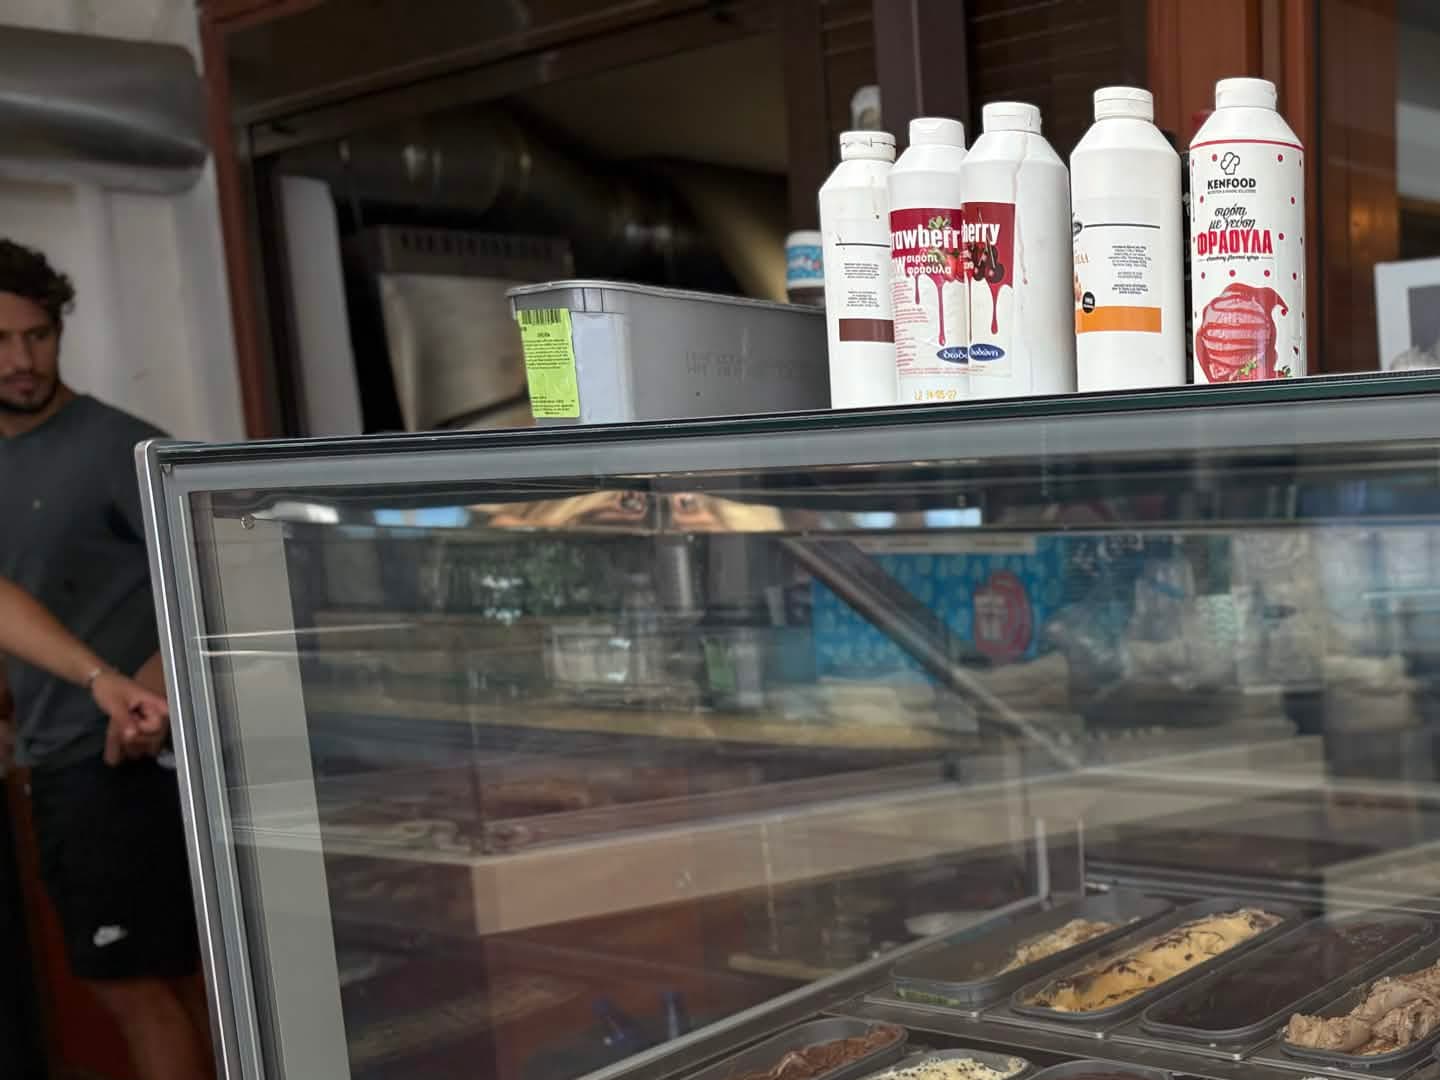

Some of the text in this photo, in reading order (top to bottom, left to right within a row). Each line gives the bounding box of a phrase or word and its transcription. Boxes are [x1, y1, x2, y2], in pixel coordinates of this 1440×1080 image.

[1207, 178, 1256, 189] KENFOOD
[890, 223, 961, 250] rawberr
[961, 219, 1000, 245] herry
[1197, 229, 1273, 256] ΦΡΑΟΥΛΑ
